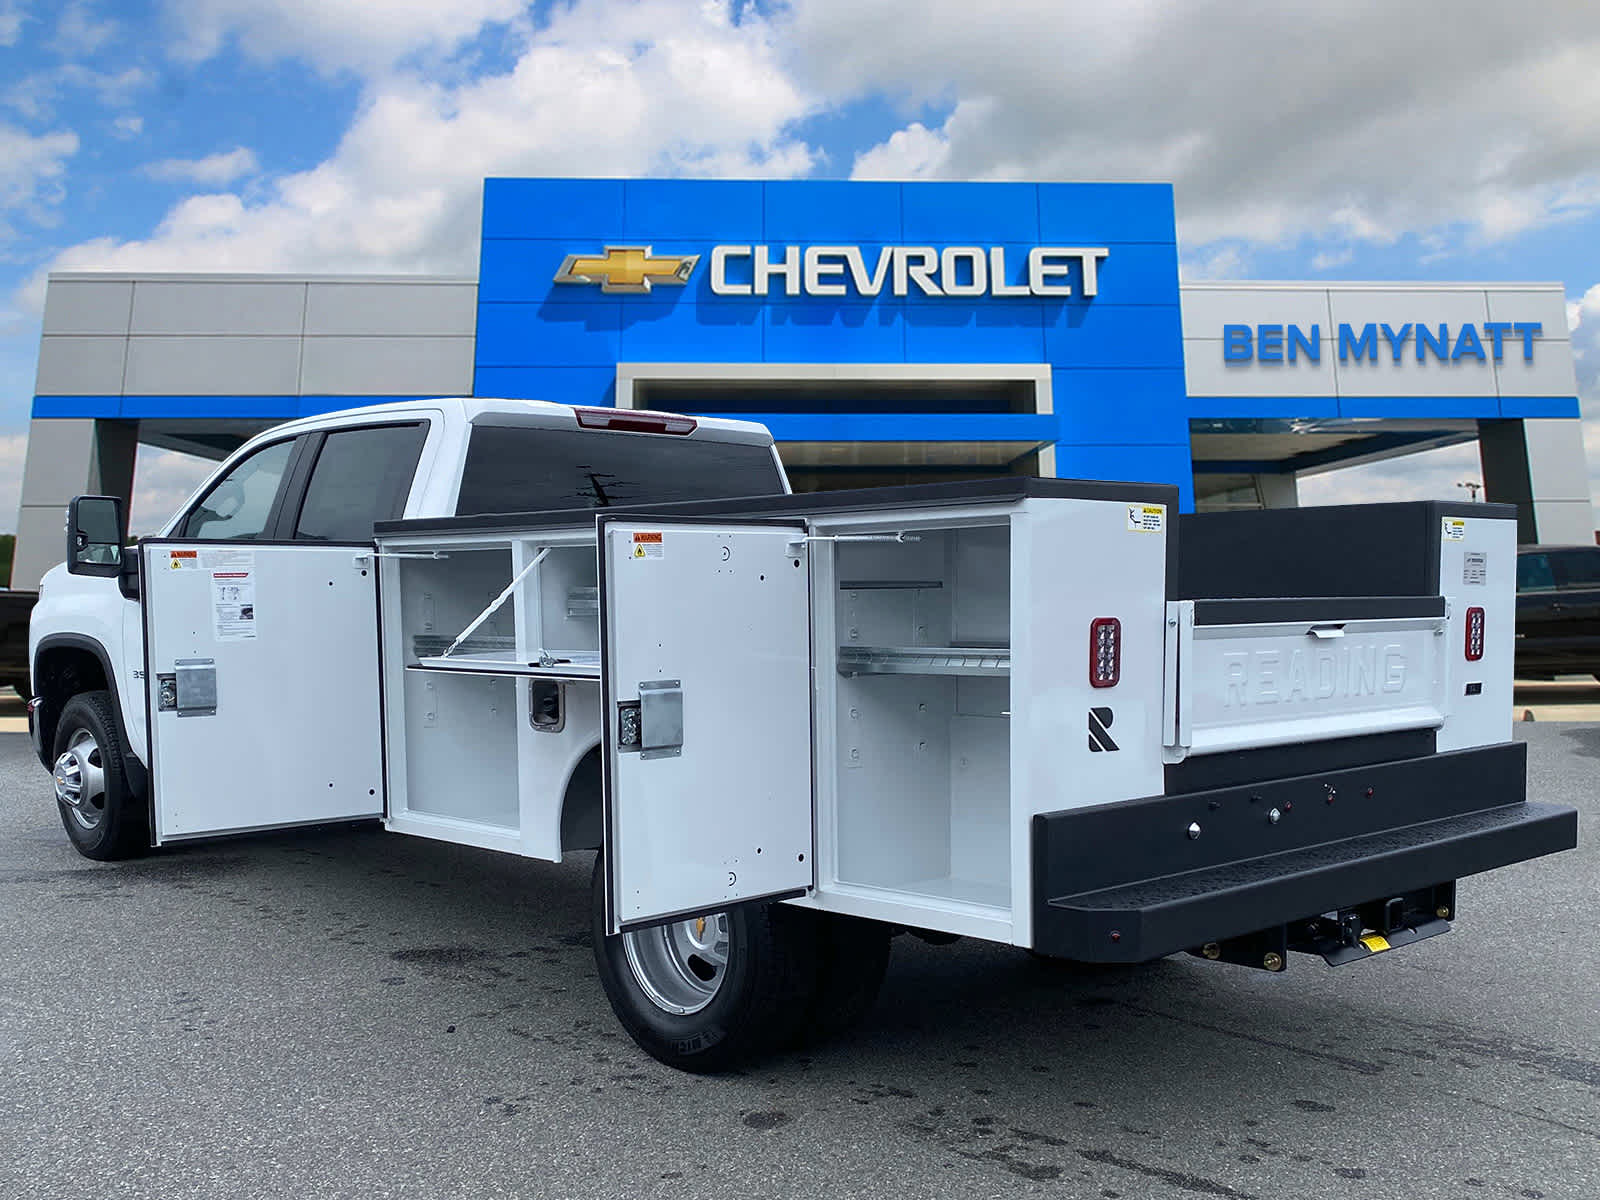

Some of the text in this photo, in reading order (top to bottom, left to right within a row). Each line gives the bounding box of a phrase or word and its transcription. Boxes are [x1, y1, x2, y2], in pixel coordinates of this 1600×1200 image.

[710, 245, 1110, 298] CHEVROLET
[1223, 321, 1544, 363] BEN MYNATT
[1223, 644, 1408, 709] READING
